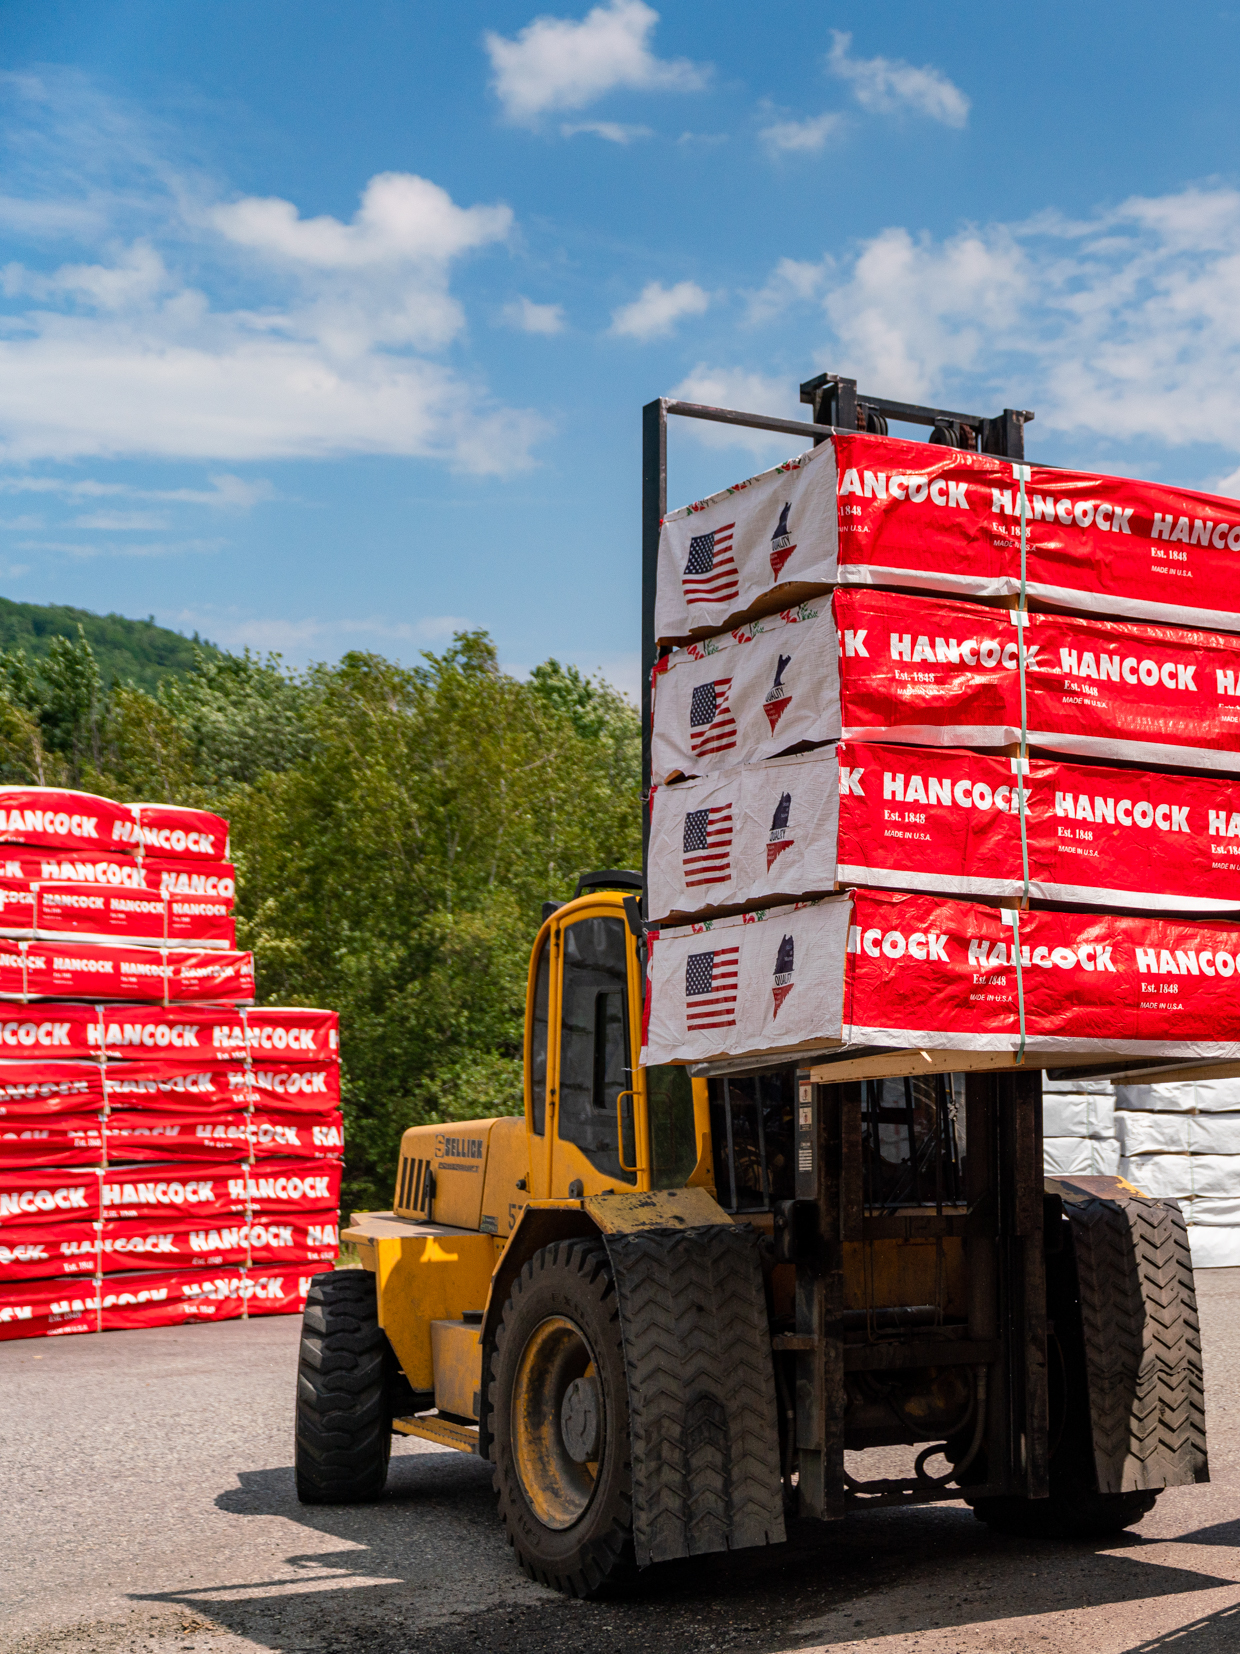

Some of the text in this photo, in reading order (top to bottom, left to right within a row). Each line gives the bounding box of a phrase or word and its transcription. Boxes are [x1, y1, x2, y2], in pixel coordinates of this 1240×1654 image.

[838, 468, 969, 509] ANCOCK
[991, 487, 1134, 535] HANCOCK
[1151, 547, 1187, 561] Est. 1848
[1151, 565, 1168, 574] MADE
[890, 633, 1040, 670] HANCOCK
[1060, 648, 1197, 691] HANCOCK
[1064, 680, 1098, 696] Est. 1848
[1221, 715, 1238, 723] MADE
[883, 772, 1032, 815] HANCOCK
[1055, 791, 1190, 833] HANCOCK
[884, 810, 925, 823] Est. 1848
[112, 820, 215, 854] HANCOCK
[885, 830, 903, 838] MADE
[913, 833, 931, 841] U.S.A.
[1058, 827, 1093, 841] Est. 1848
[1059, 846, 1076, 854] MADE
[1212, 844, 1227, 854] Est.
[53, 957, 113, 973] HANCOCK
[988, 975, 1006, 986] 1848
[1141, 983, 1178, 993] Est. 1848
[87, 1024, 316, 1049] HANCOCK HANCOCK
[445, 1138, 483, 1158] SELLICK
[103, 1177, 329, 1205] HANCOCK HANCOCK
[189, 1226, 294, 1251] HANCOCK
